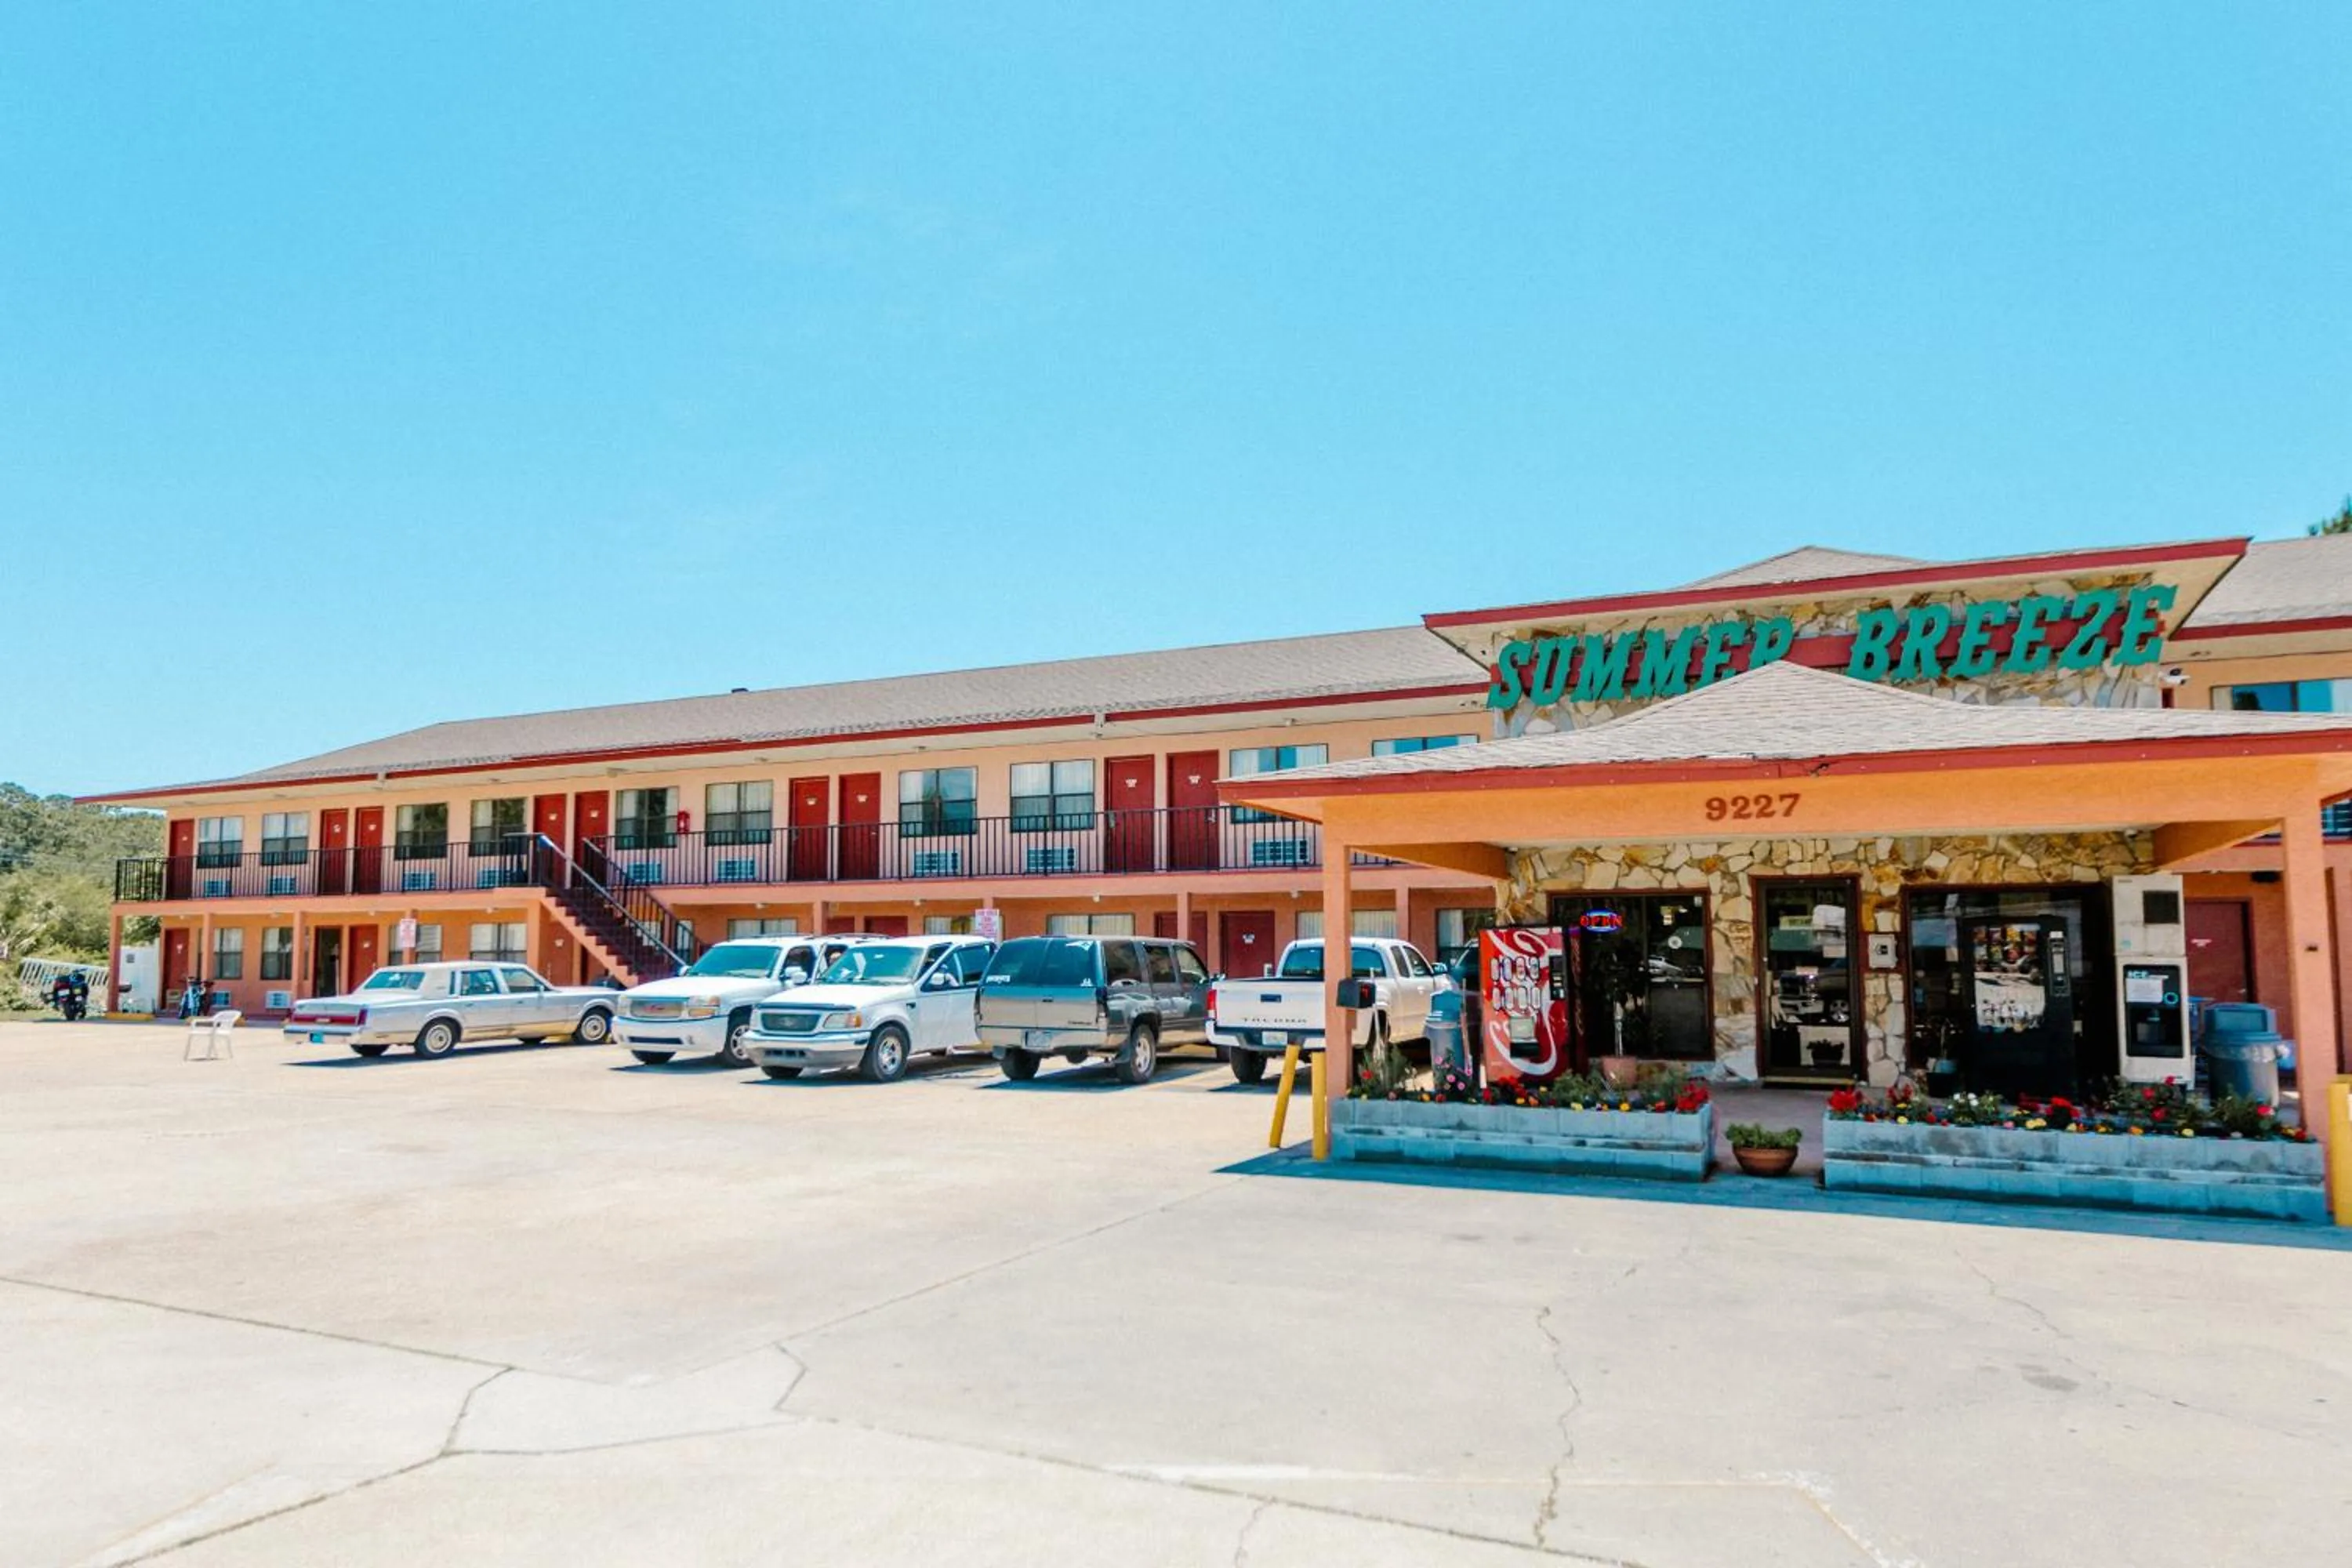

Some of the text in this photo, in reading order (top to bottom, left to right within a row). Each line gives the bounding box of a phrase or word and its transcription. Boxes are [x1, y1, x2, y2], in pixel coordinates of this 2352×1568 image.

[1486, 584, 2180, 710] SUMMER BREEZE
[1704, 792, 1802, 822] 9227
[1579, 915, 1624, 928] OPEN
